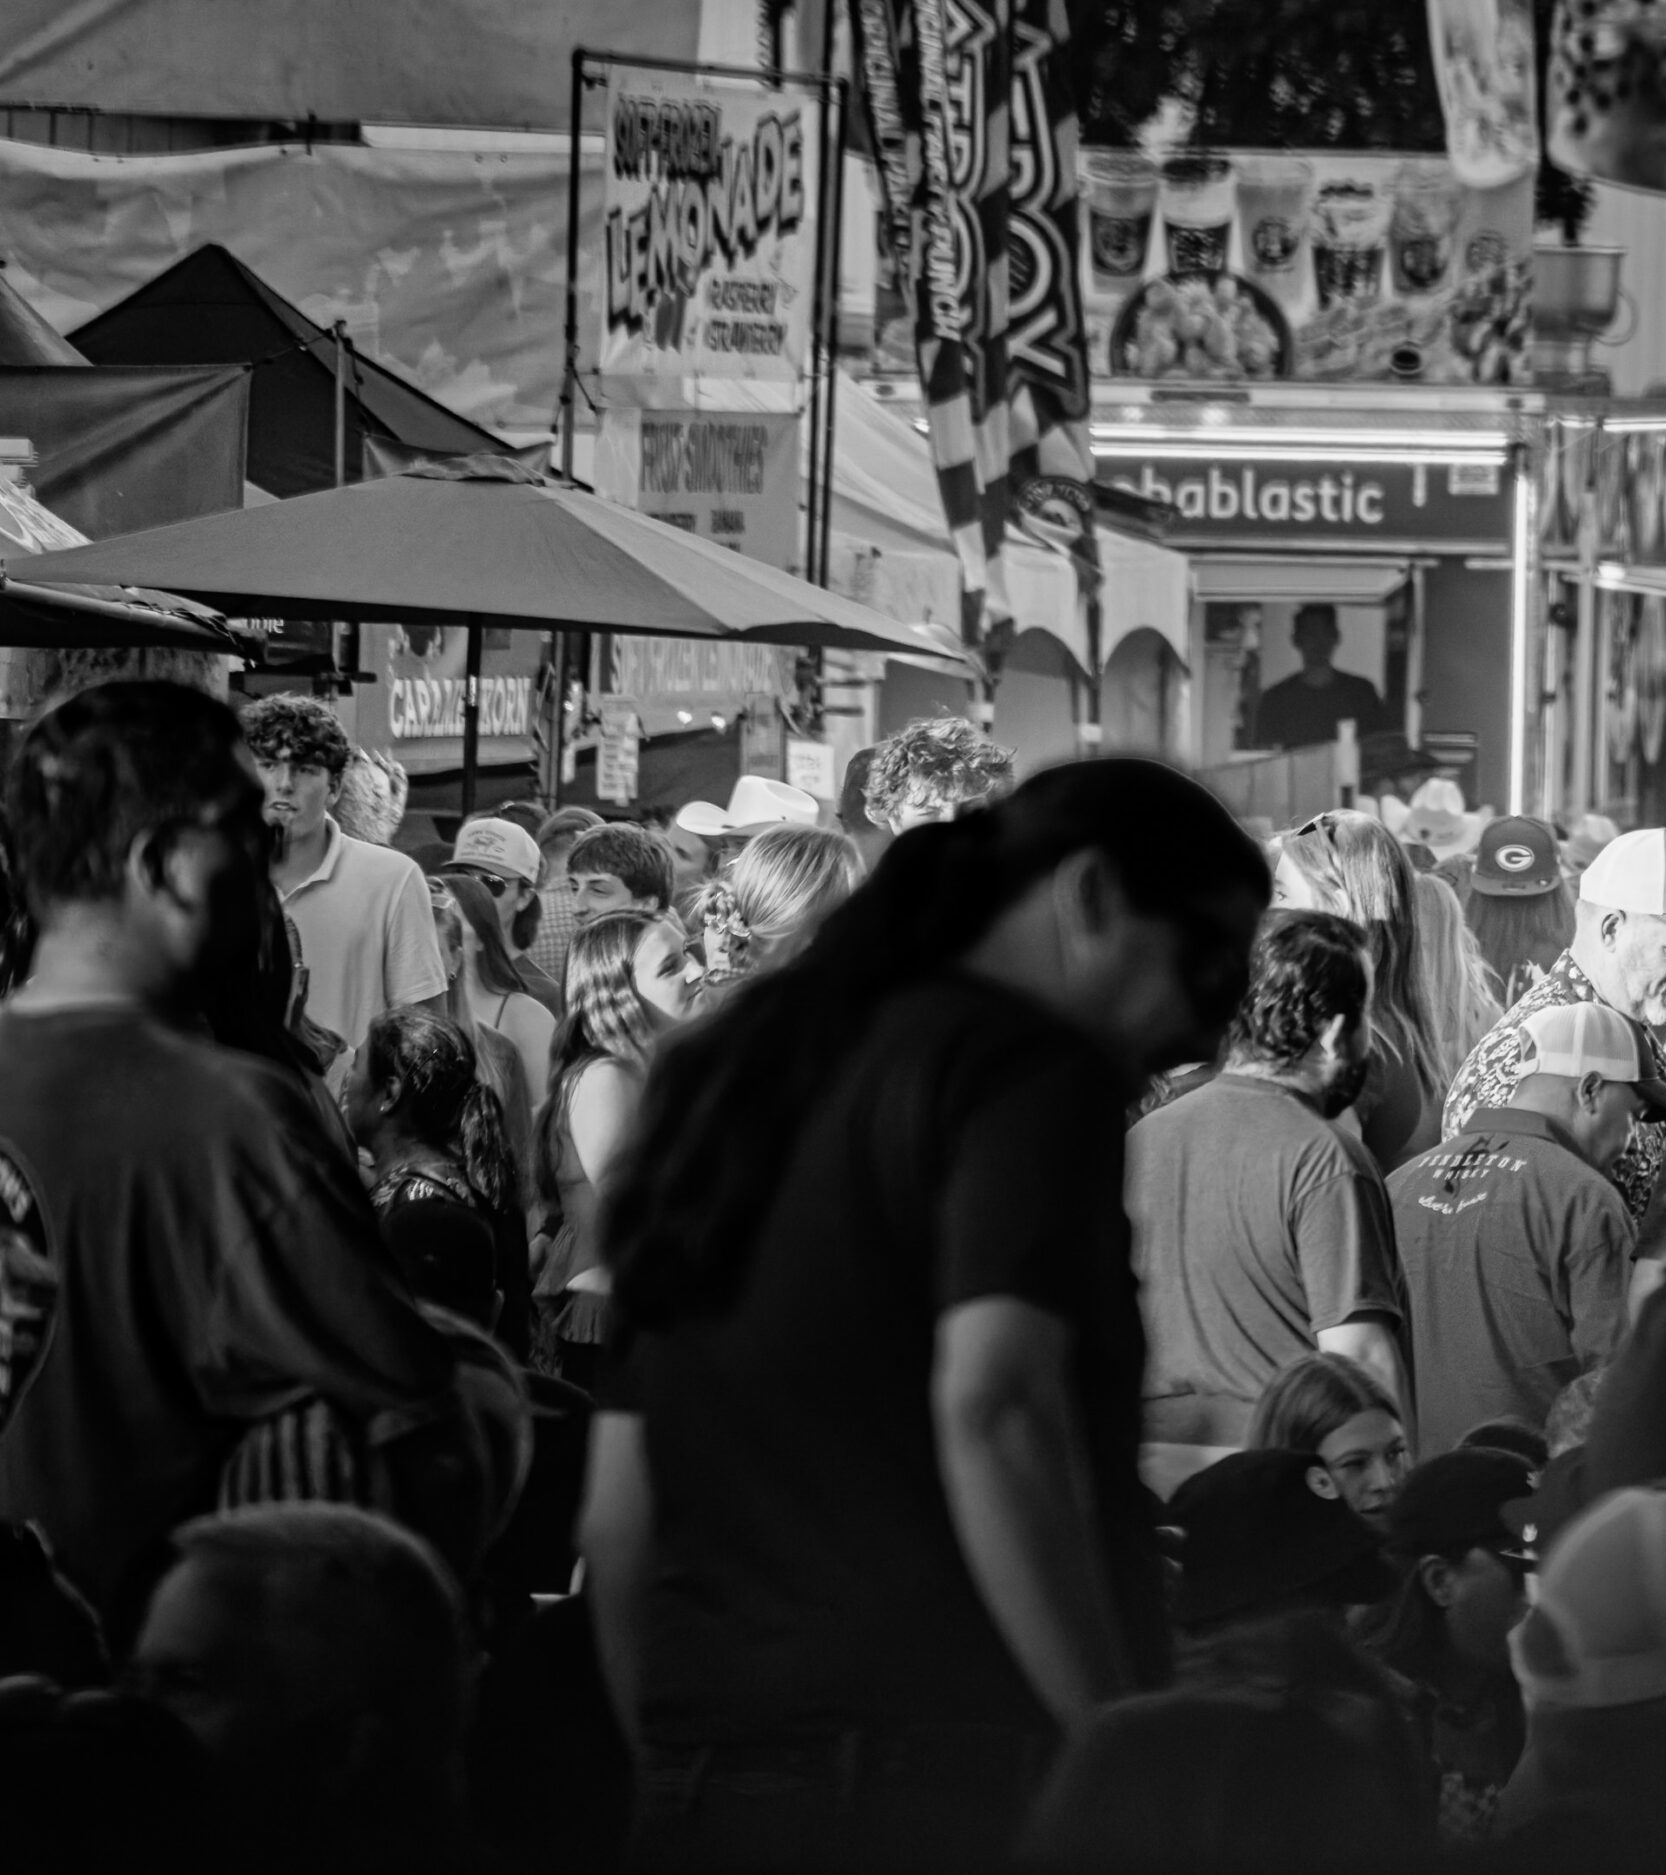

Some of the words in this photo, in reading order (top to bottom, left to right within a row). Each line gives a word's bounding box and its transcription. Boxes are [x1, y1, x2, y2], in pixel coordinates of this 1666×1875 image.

[606, 109, 805, 335] LEMONADE
[927, 226, 962, 341] PUNCH
[390, 676, 466, 738] CARAME
[479, 675, 532, 736] KORN
[1496, 845, 1534, 871] G
[1418, 1153, 1528, 1172] PENDLETON
